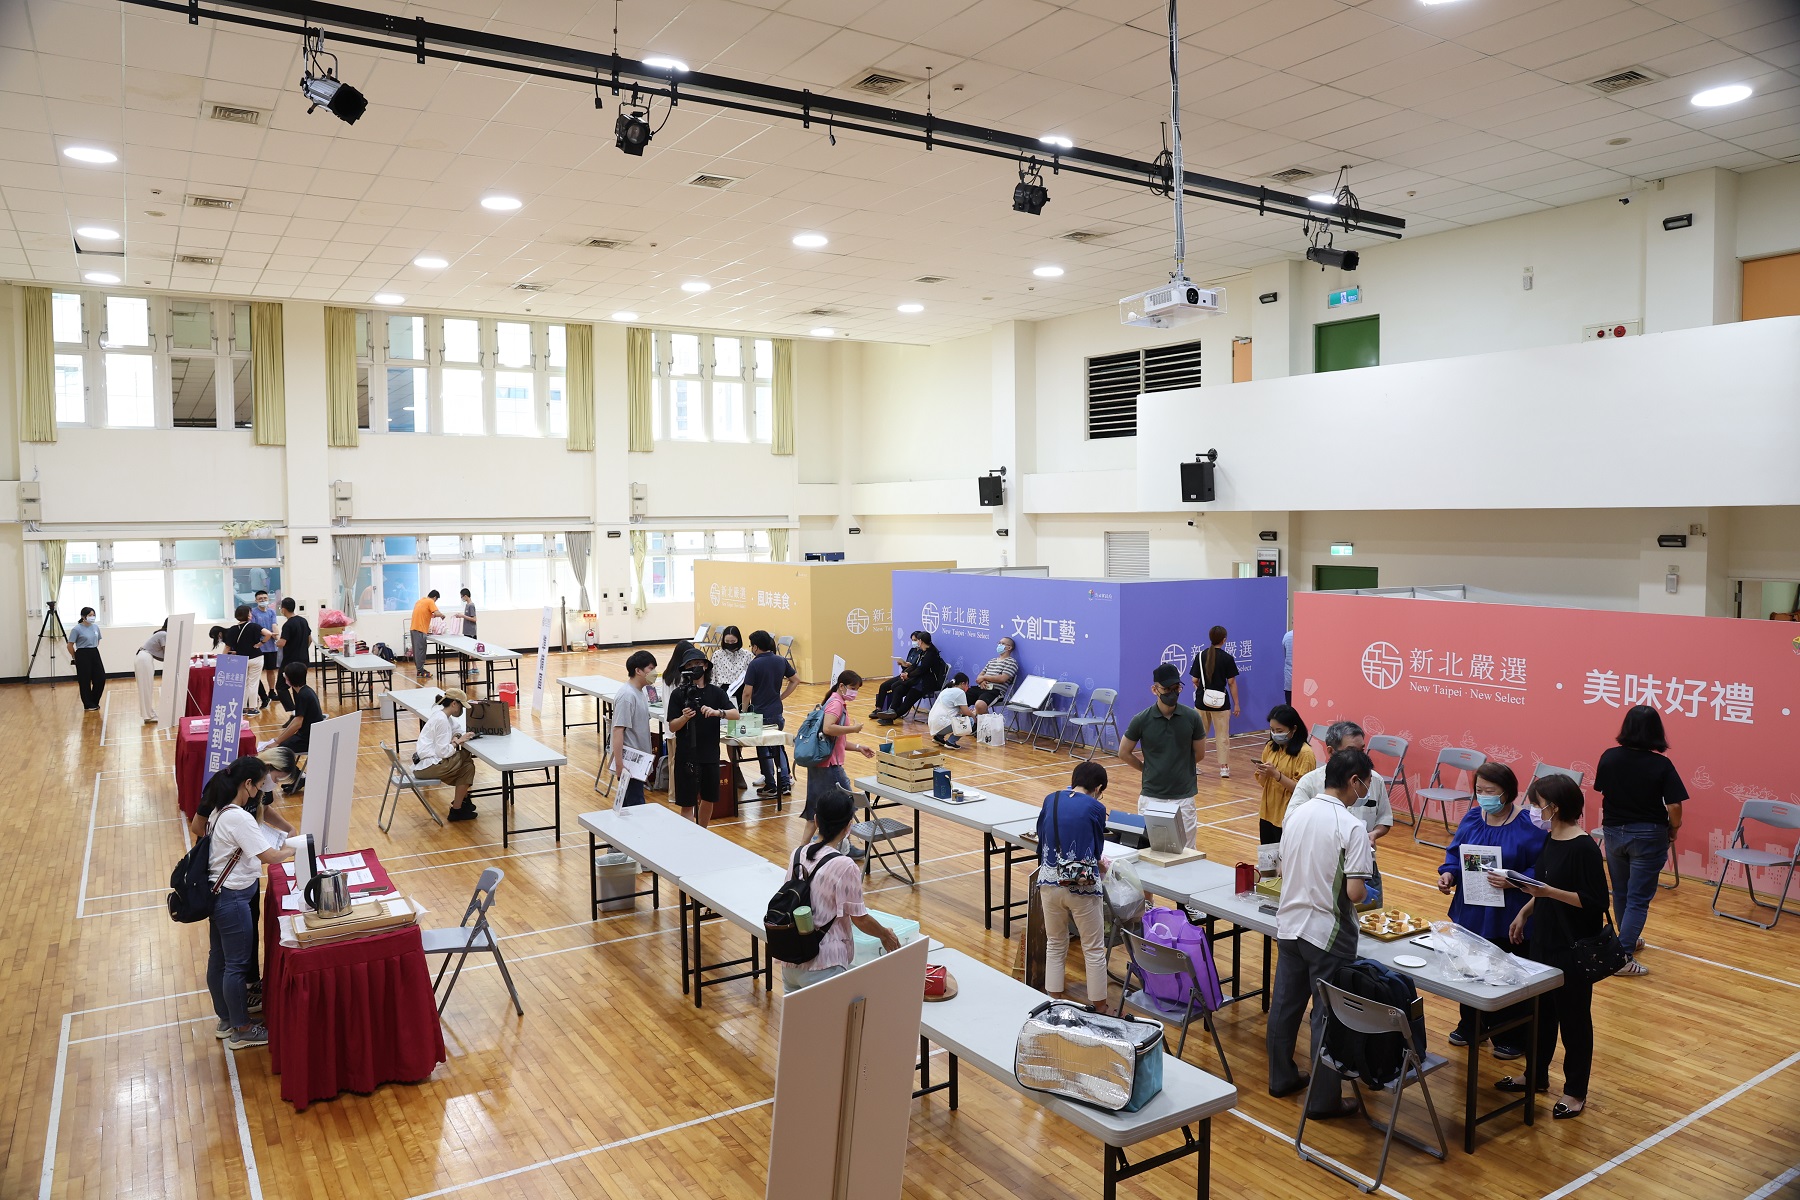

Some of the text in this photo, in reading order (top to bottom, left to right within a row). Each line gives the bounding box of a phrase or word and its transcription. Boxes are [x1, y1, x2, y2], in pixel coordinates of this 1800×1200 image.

[757, 590, 790, 610] 風味美食
[941, 605, 990, 627] 新北嚴選
[1011, 614, 1076, 645] 文創工藝
[1409, 648, 1527, 684] 新北嚴選
[1409, 681, 1526, 706] New Taipei New Select
[1583, 668, 1755, 725] 美味好禮
[208, 704, 226, 773] 報到區
